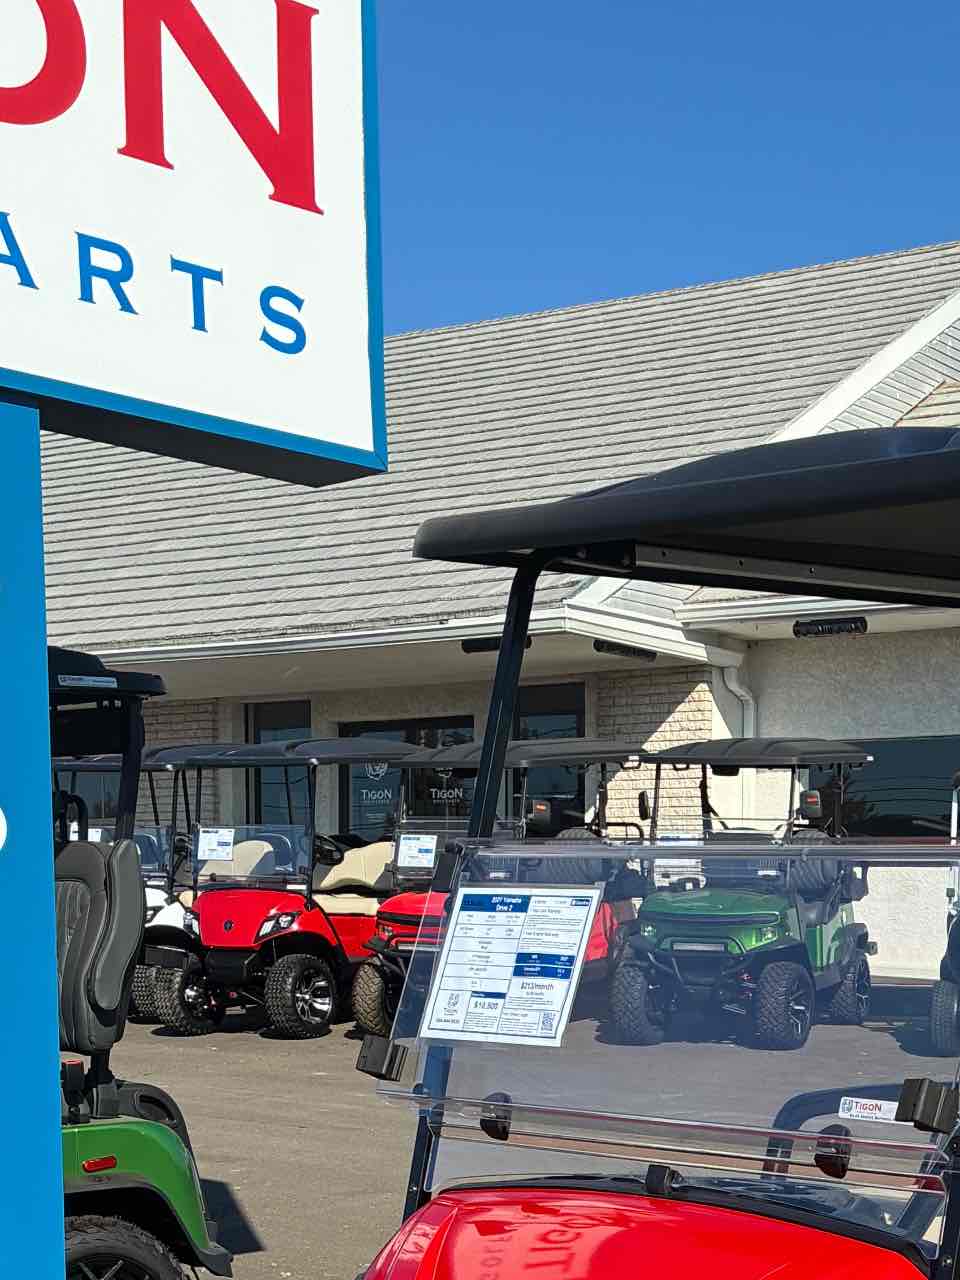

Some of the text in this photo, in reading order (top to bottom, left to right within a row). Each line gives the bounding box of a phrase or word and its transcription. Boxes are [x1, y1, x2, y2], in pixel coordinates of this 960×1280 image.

[361, 789, 392, 800] TIGON
[430, 788, 463, 799] TIGON
[854, 1101, 882, 1111] TIGON
